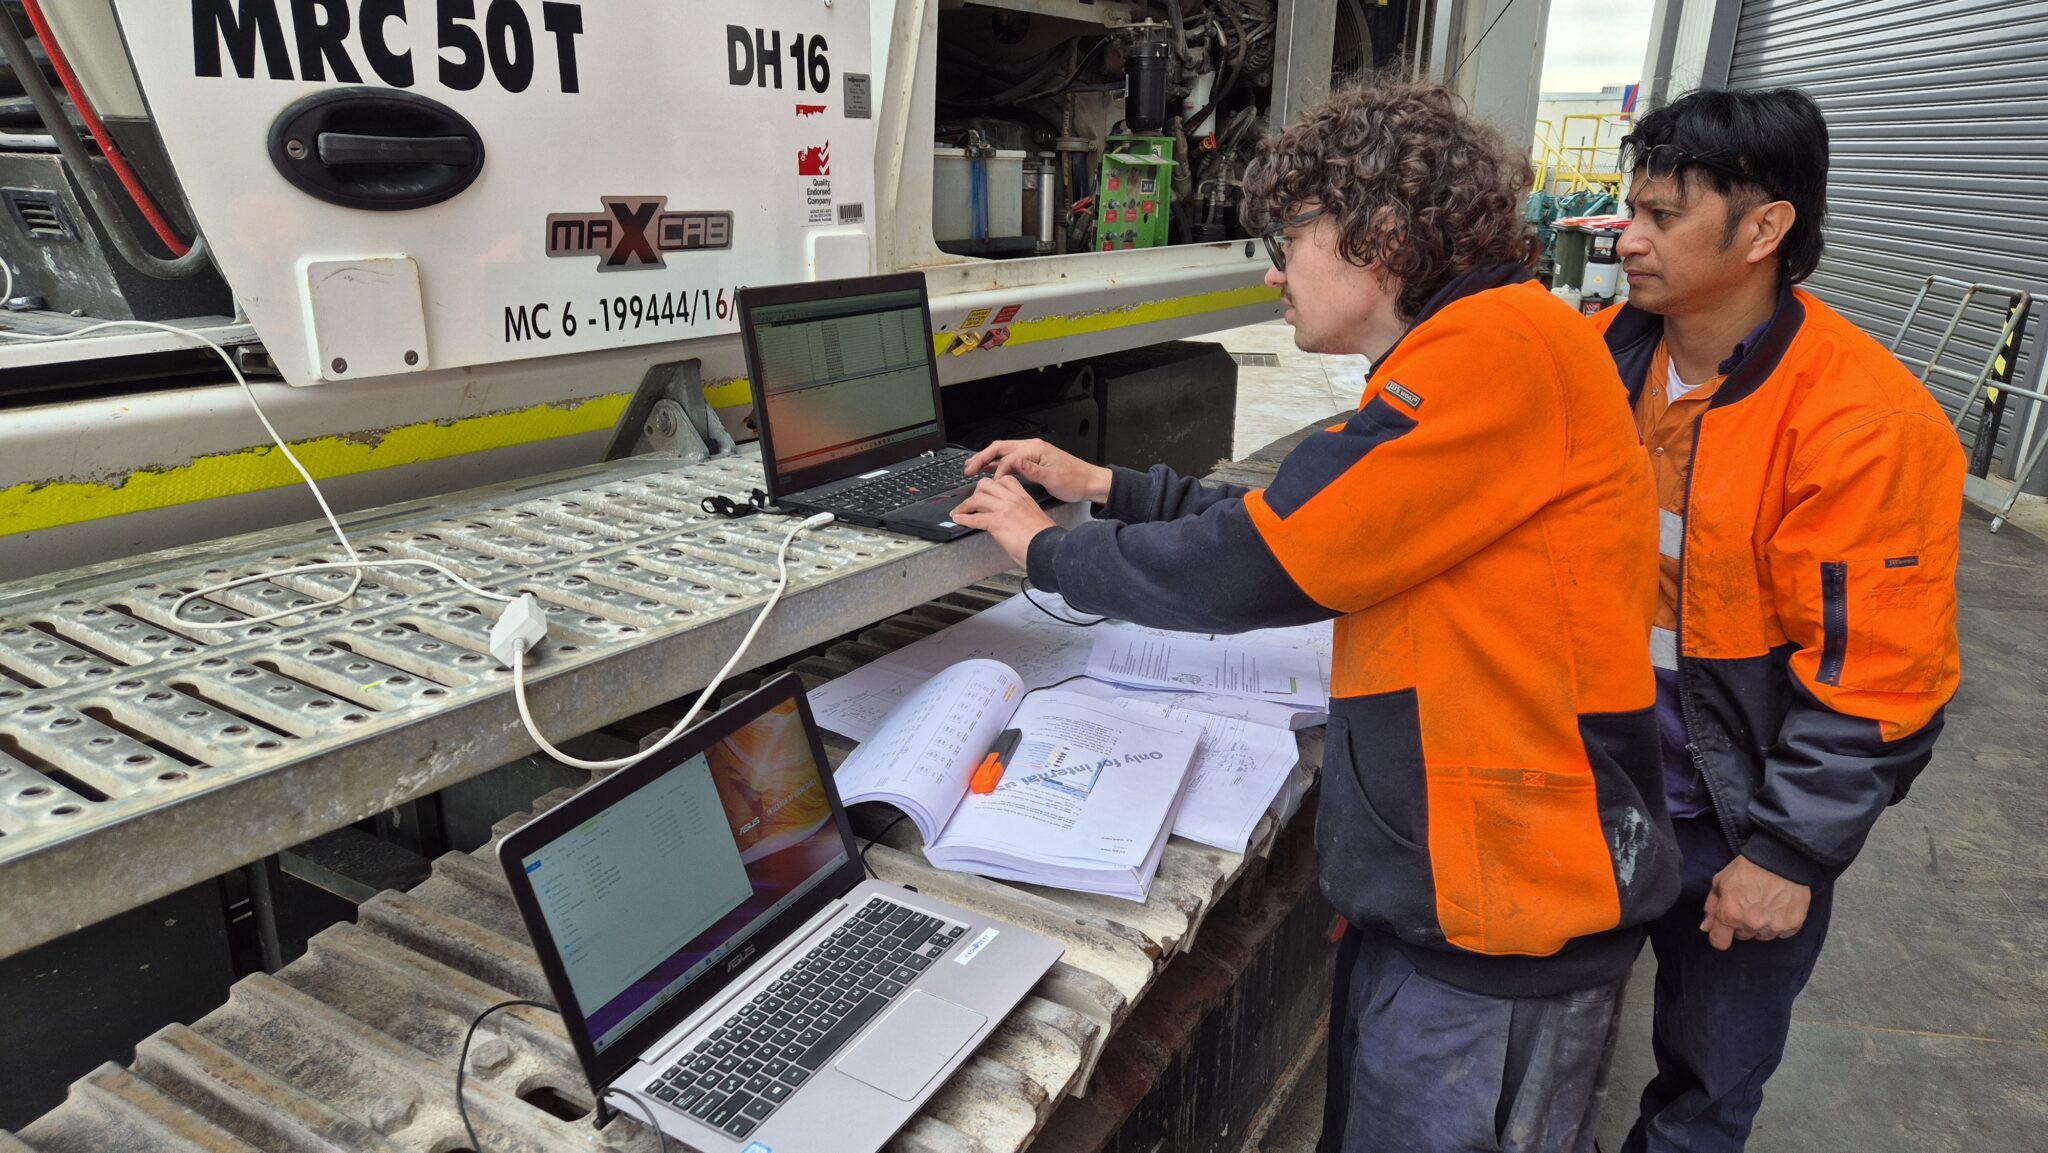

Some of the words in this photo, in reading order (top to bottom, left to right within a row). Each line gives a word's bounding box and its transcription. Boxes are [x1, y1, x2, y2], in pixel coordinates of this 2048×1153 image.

[193, 0, 415, 88] MRC
[726, 24, 782, 89] DH
[789, 33, 831, 93] 16
[806, 188, 831, 196] Endorsed
[812, 178, 831, 188] Quality
[807, 197, 831, 206] Company
[505, 303, 551, 343] MC
[562, 301, 577, 337] 6
[1097, 757, 1122, 769] for
[1124, 751, 1164, 765] Only
[1021, 763, 1094, 787] internal
[739, 816, 760, 837] ASUS
[727, 943, 756, 973] ASUS
